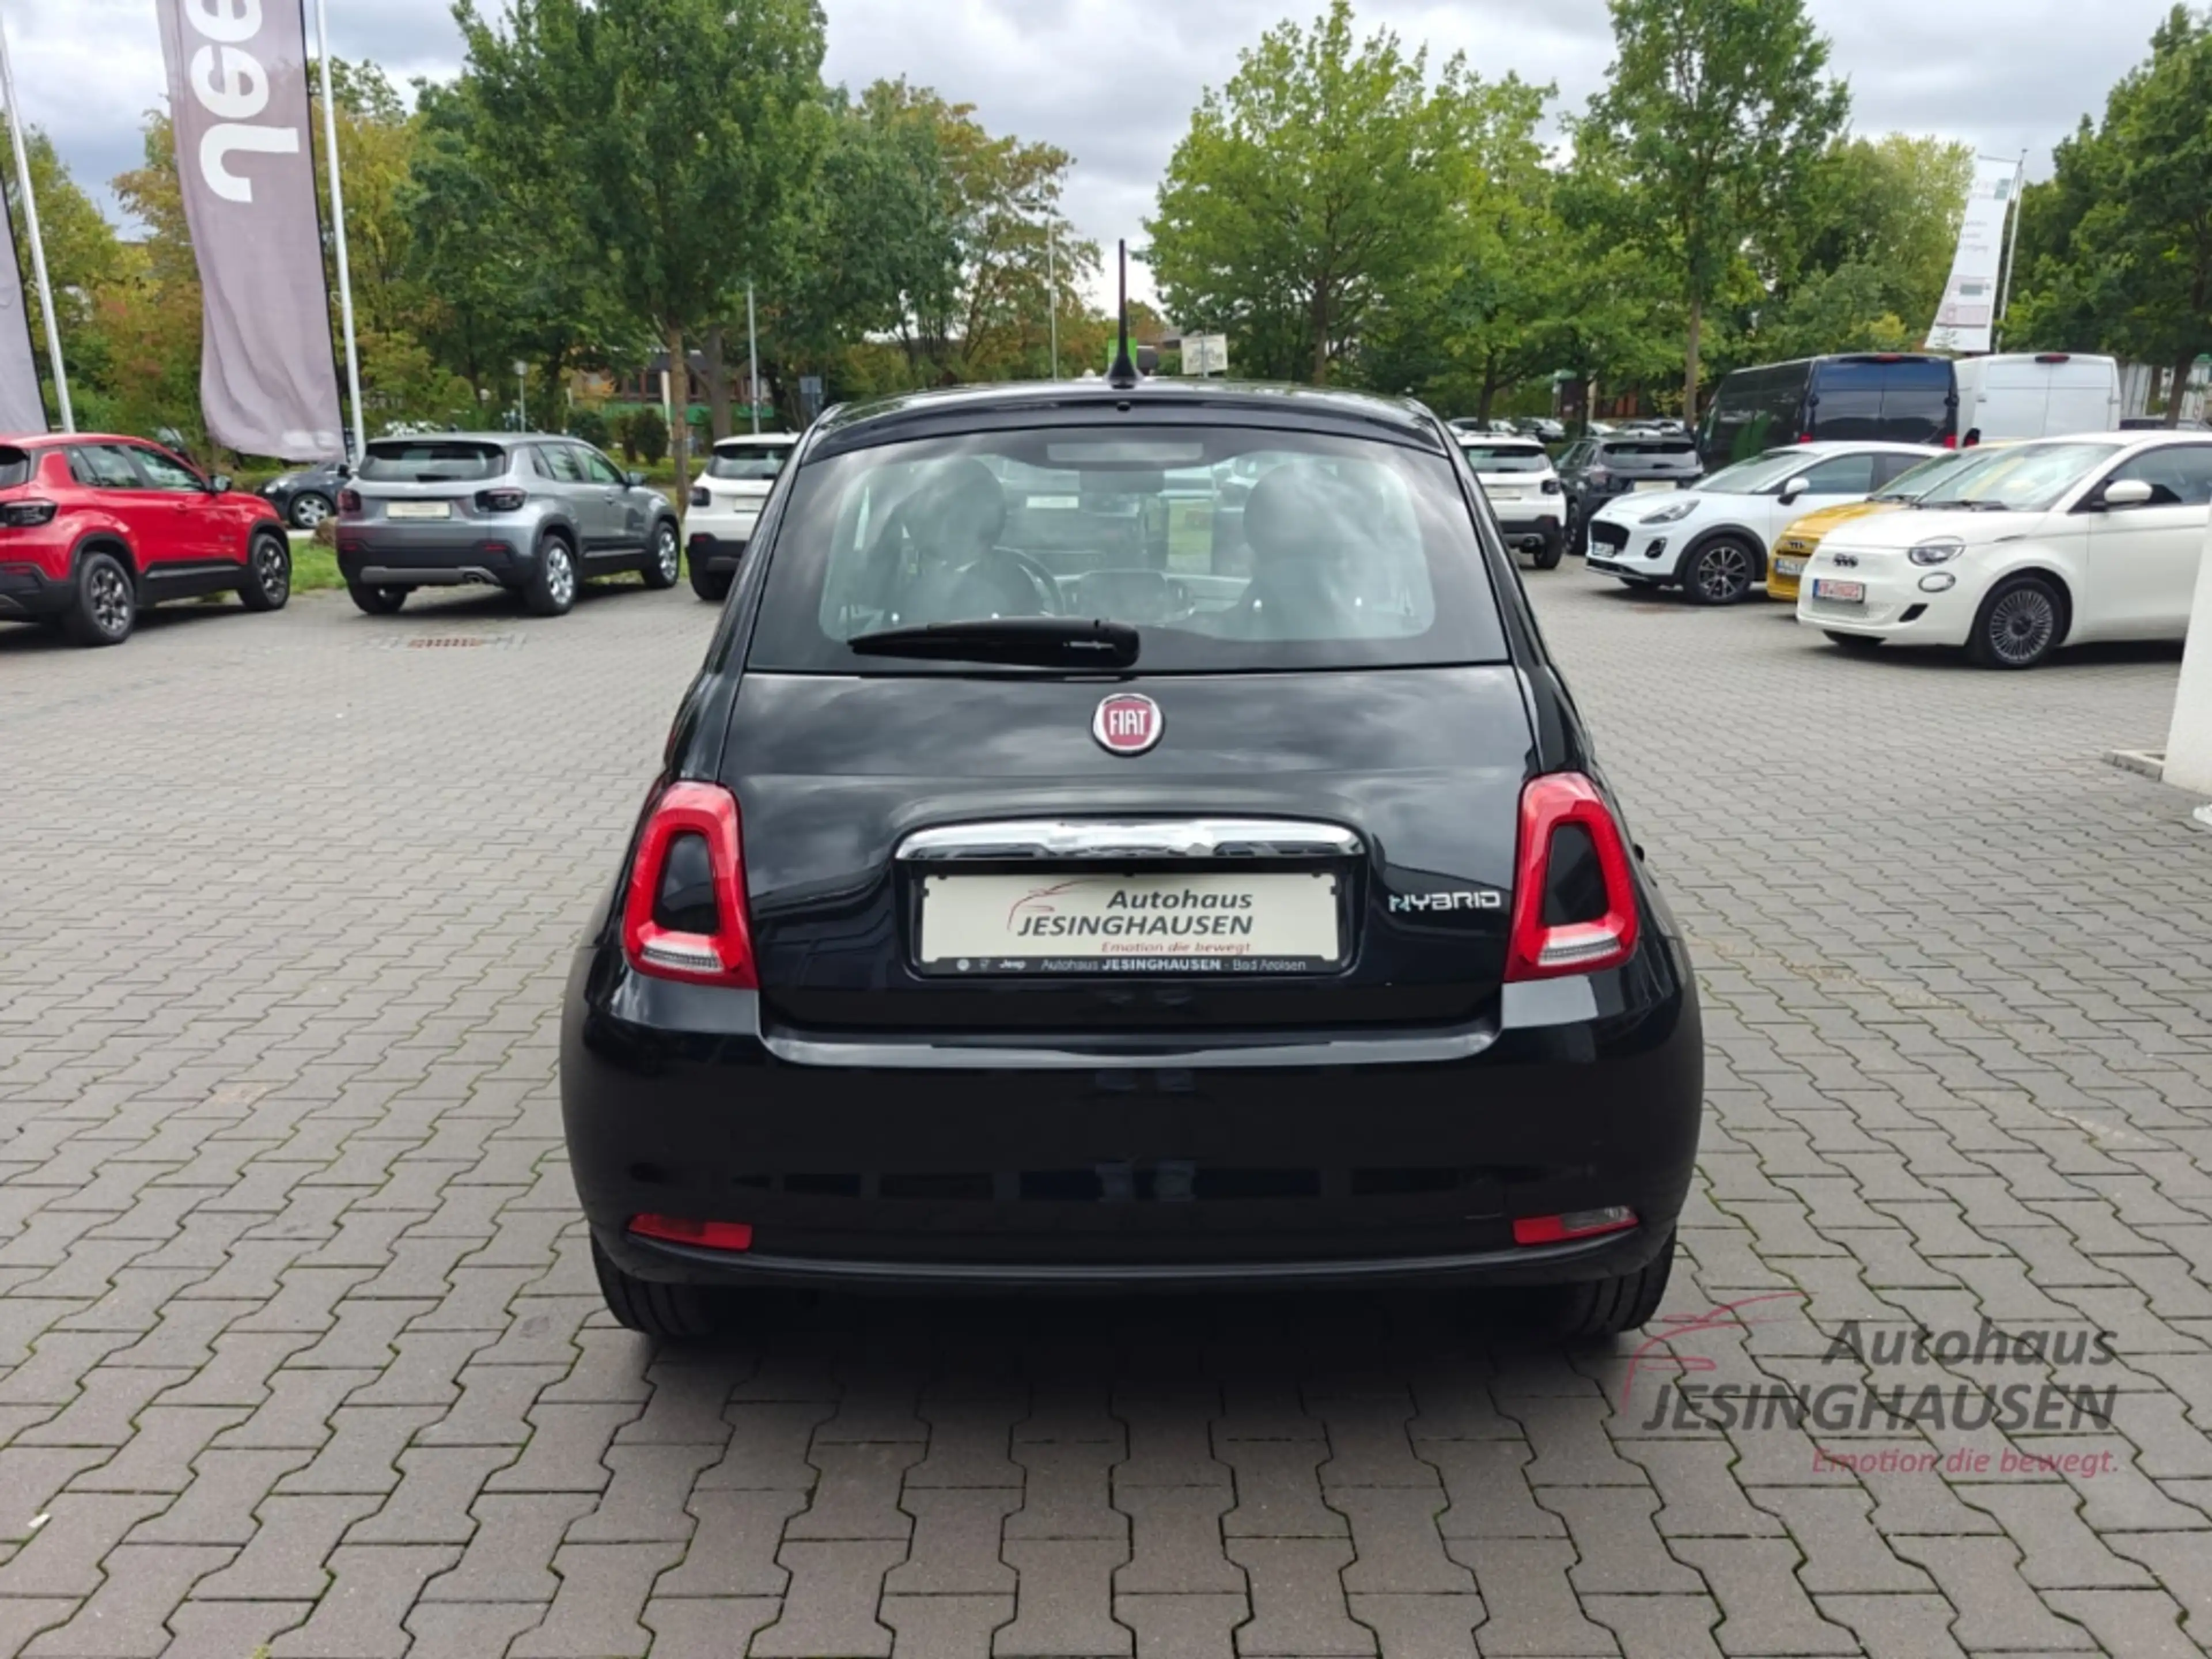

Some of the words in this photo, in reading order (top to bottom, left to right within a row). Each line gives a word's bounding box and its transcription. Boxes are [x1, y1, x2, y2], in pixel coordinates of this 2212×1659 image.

[1109, 710, 1147, 736] FIAT
[1107, 889, 1252, 909] Autohaus
[1388, 892, 1501, 912] HYBRID
[1017, 915, 1253, 936] JESINGHAUSEN
[1101, 941, 1163, 953] Emotion
[1168, 941, 1191, 952] die
[1041, 959, 1099, 971] Autohaus
[1102, 959, 1221, 971] JESINGHAUSEN
[1233, 959, 1256, 971] Bad
